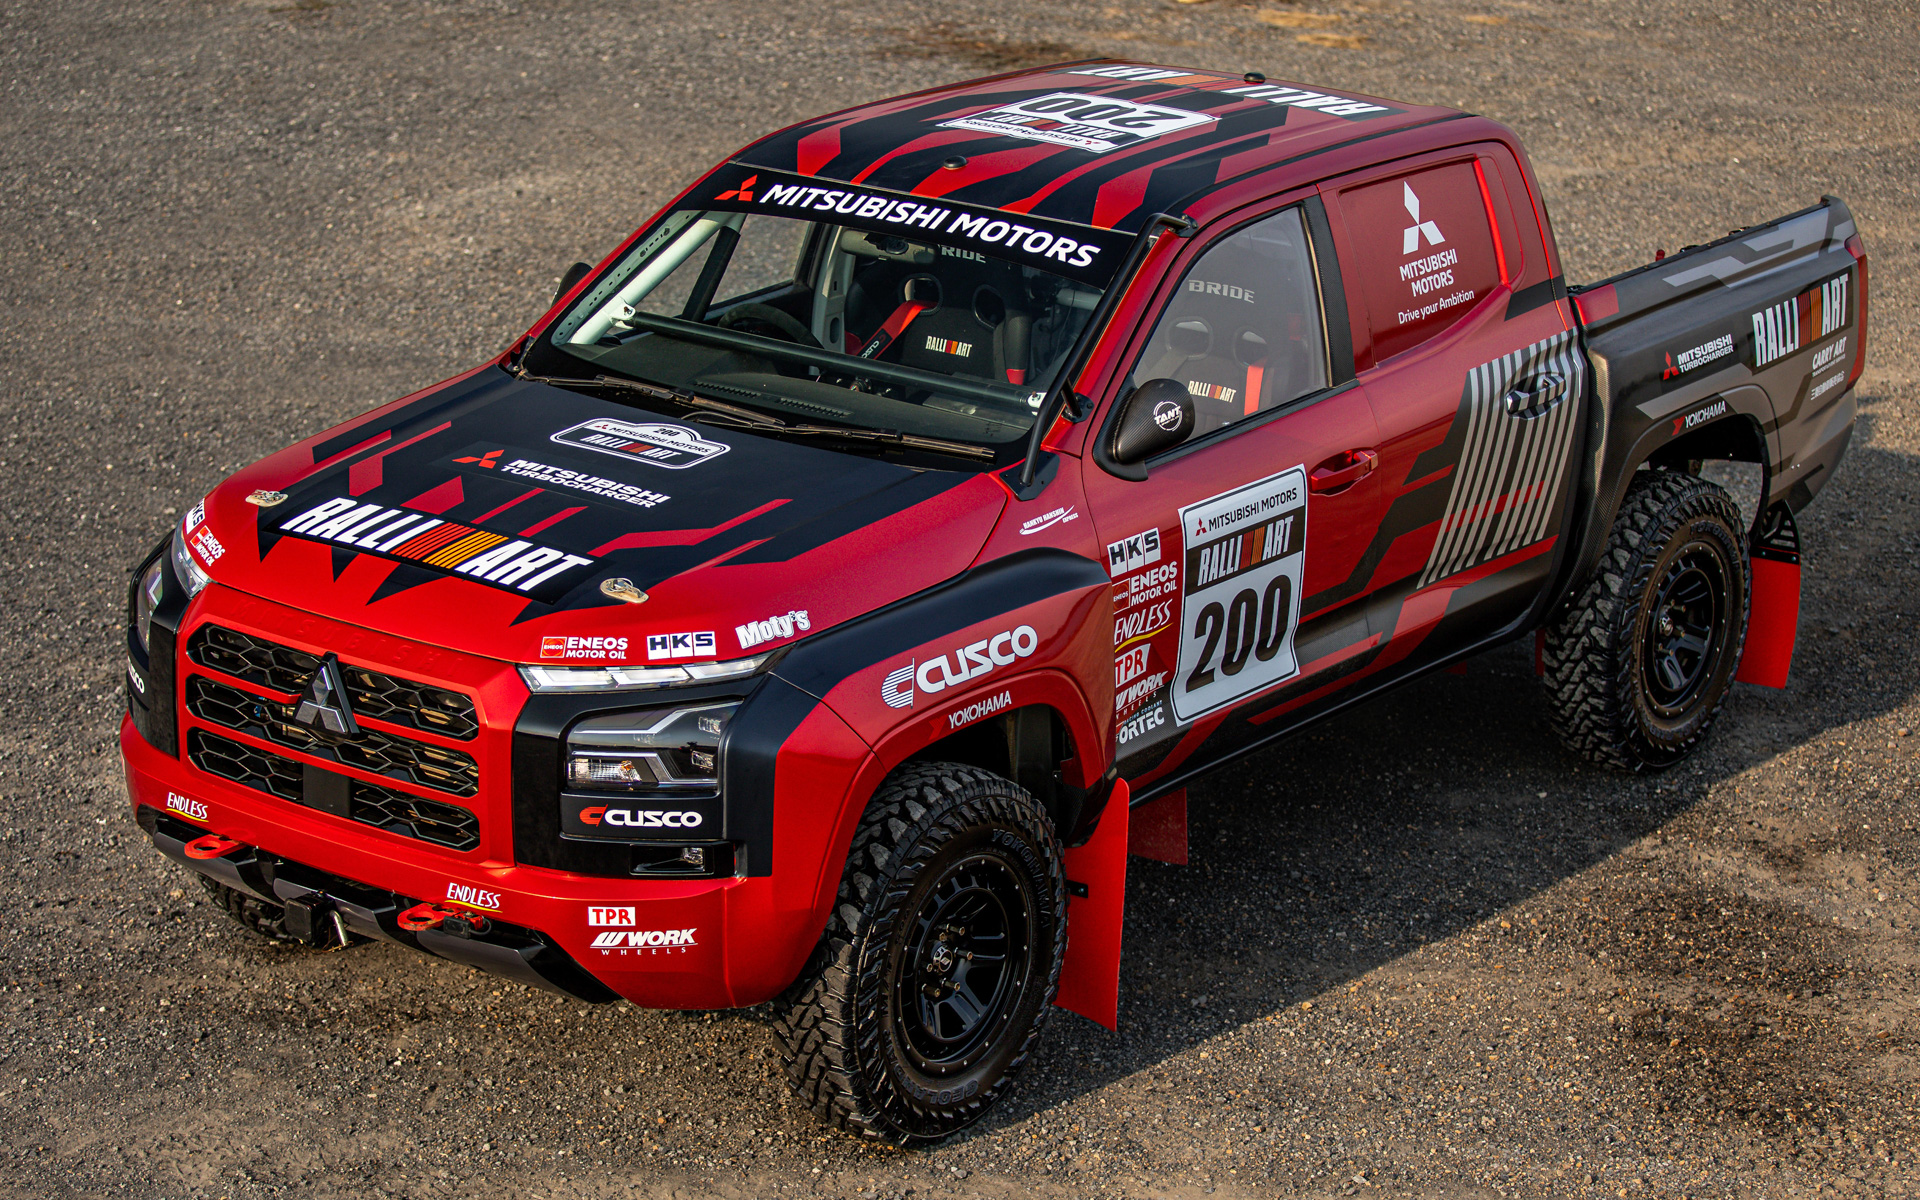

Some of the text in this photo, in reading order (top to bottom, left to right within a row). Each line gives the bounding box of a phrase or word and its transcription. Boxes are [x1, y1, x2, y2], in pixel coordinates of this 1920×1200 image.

[1018, 97, 1187, 129] 200
[759, 183, 1101, 268] MITSUBISHI MOTORS
[938, 244, 986, 264] RIDE
[1399, 248, 1458, 281] MITSUBISHI
[1188, 279, 1255, 304] BRIDE
[1411, 269, 1454, 297] MOTORS
[1399, 290, 1475, 325] Drive your Ambition
[1677, 333, 1733, 365] MITSUBISHI
[1679, 345, 1734, 373] TURBOCHARGER
[1812, 343, 1835, 370] CARRY
[1833, 336, 1847, 358] ART
[1154, 405, 1181, 425] TANT
[1684, 400, 1727, 429] YOKOHAMA
[609, 426, 713, 454] MITSUBISHI MOTORS
[653, 427, 680, 437] 200
[501, 465, 658, 509] TURBOCHARGER
[507, 459, 672, 504] MITSUBISHI
[1022, 515, 1044, 530] HANKYU
[1208, 487, 1297, 532] MITSUBISHI MOTORS
[1109, 530, 1160, 566] HKS
[1131, 561, 1178, 594] ENEOS
[1131, 579, 1178, 607] MOTOR OIL
[1113, 590, 1129, 602] ENEOS
[735, 610, 811, 649] Moty's
[1114, 598, 1173, 646] ENDLESS
[1185, 574, 1292, 693] 200
[565, 649, 627, 660] MOTOR OIL
[567, 636, 629, 650] ENEOS
[649, 632, 714, 651] HKS
[915, 624, 1039, 695] CUSCO
[1115, 648, 1144, 685] TPR
[1127, 670, 1169, 704] WORK
[948, 690, 1012, 730] YOKOHAMA
[1116, 706, 1165, 744] ORTEC
[167, 791, 209, 821] ENDLESS
[604, 809, 703, 828] CUSCO
[991, 828, 1051, 929] YOKOHAMA
[447, 881, 501, 910] ENDLESS
[591, 908, 632, 925] TPR
[601, 946, 687, 956] WHEELS
[627, 927, 698, 948] WORK
